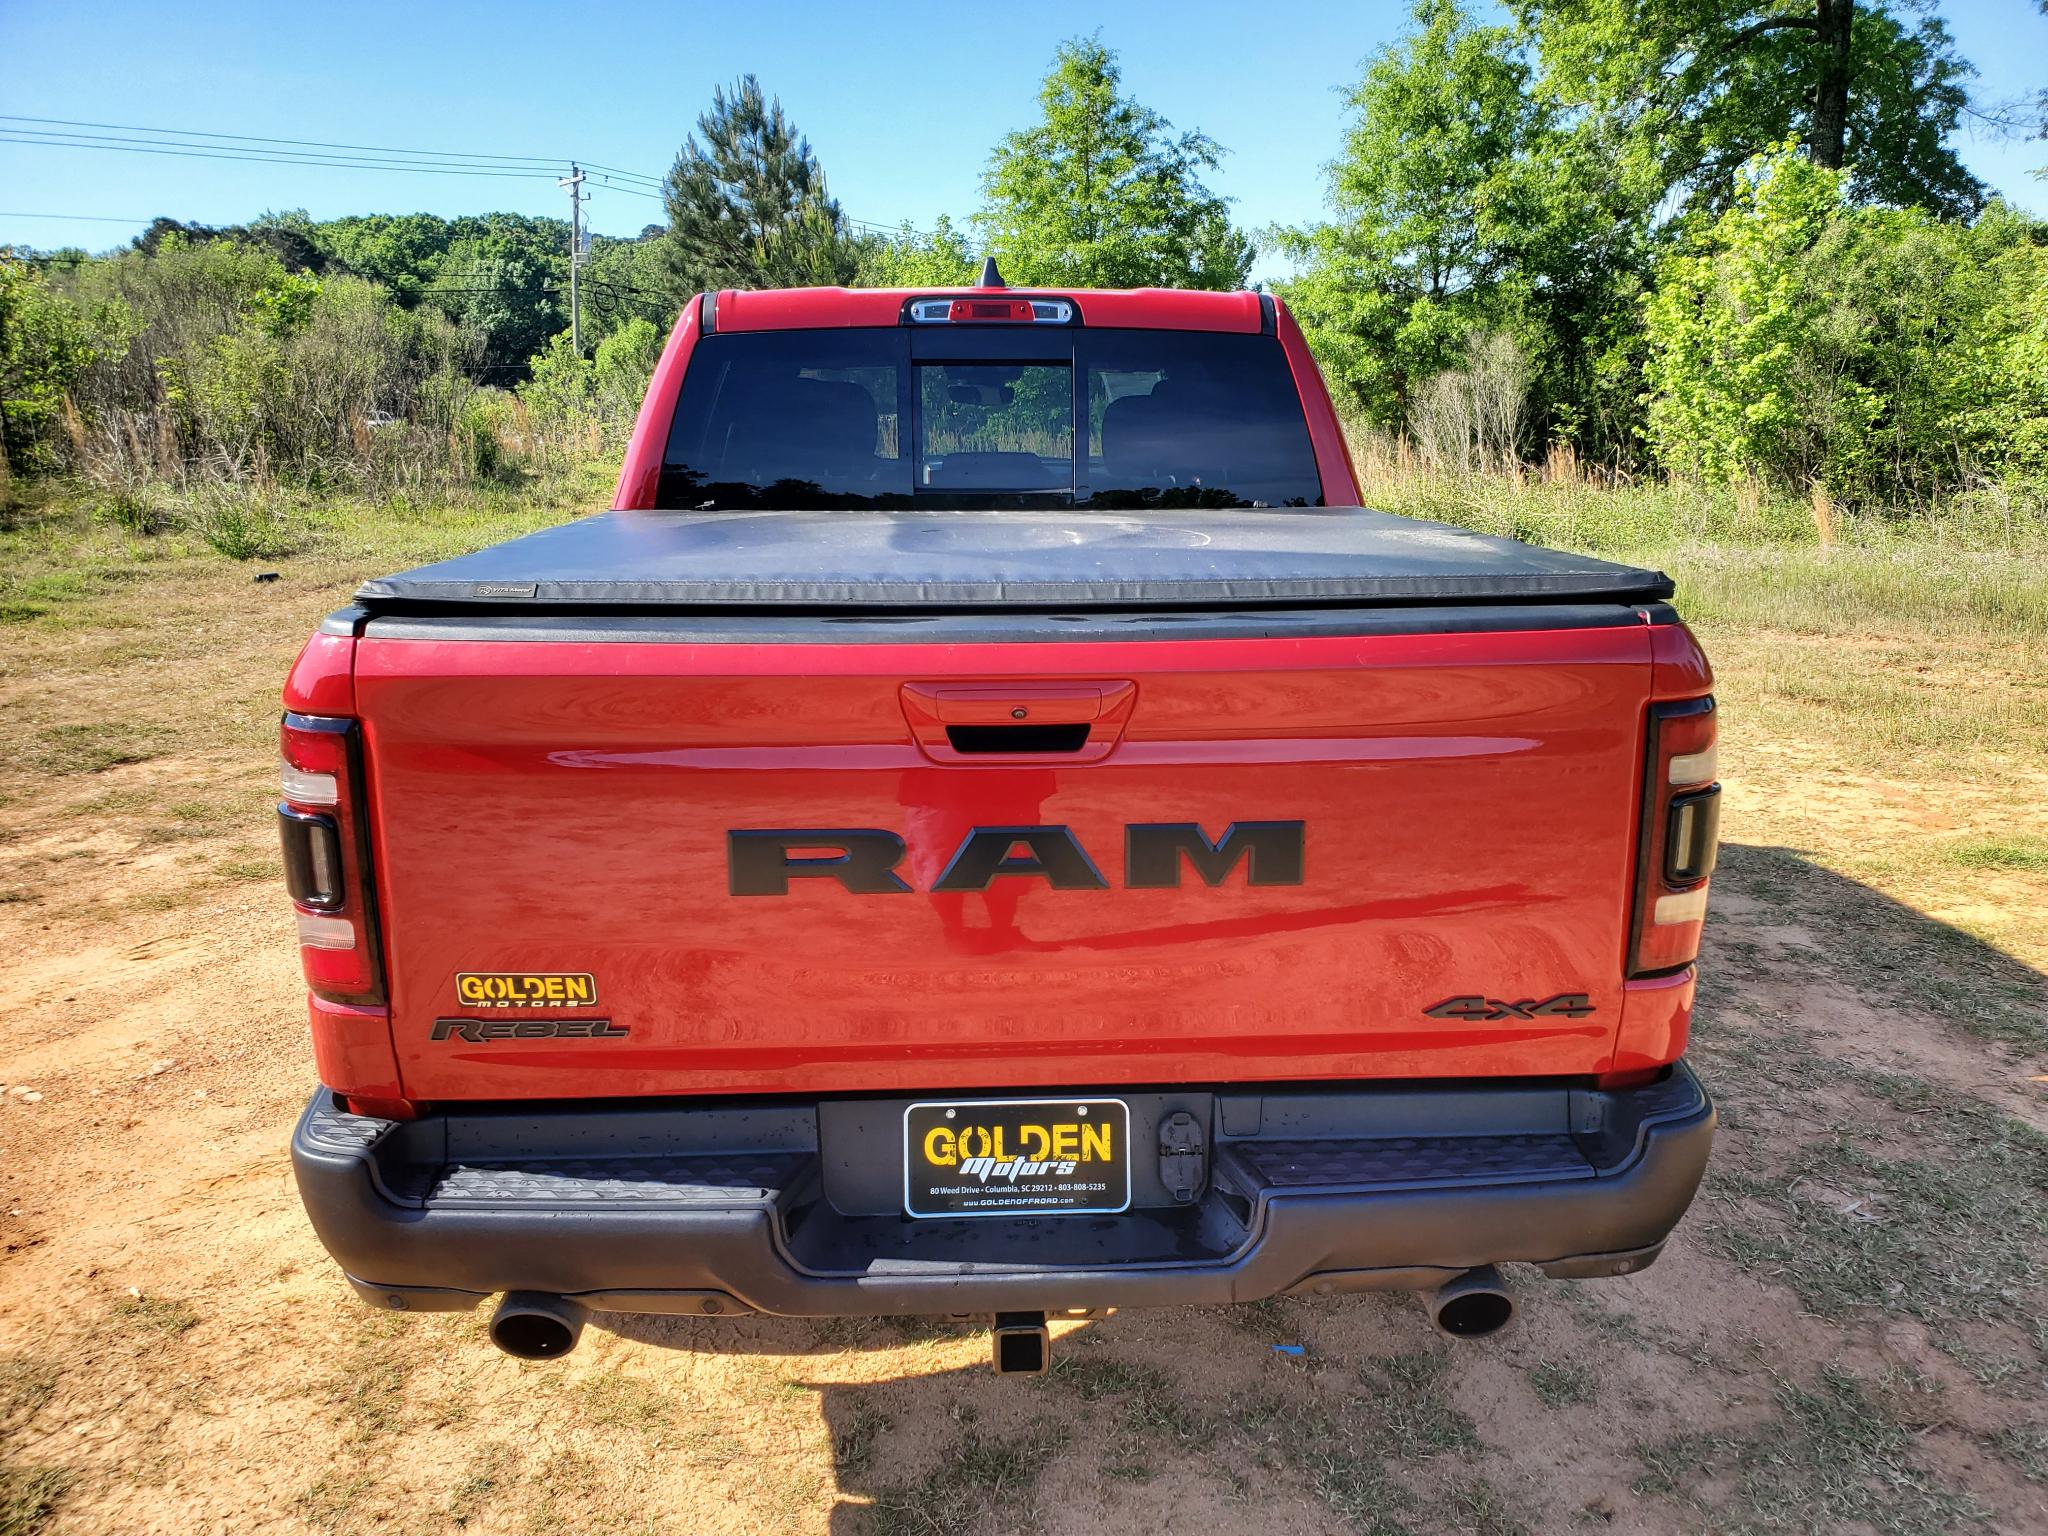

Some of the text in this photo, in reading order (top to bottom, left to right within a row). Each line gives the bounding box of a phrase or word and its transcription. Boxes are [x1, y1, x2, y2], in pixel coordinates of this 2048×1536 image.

[727, 820, 1305, 896] RAM
[461, 977, 588, 999] GOLDEN
[429, 1019, 629, 1043] REBEL
[924, 1123, 1111, 1166] GOLDEN
[959, 1156, 1077, 1184] Motors
[930, 1183, 1106, 1195] 80 Weed Drive Columbia, SC 29212 803-808-5235
